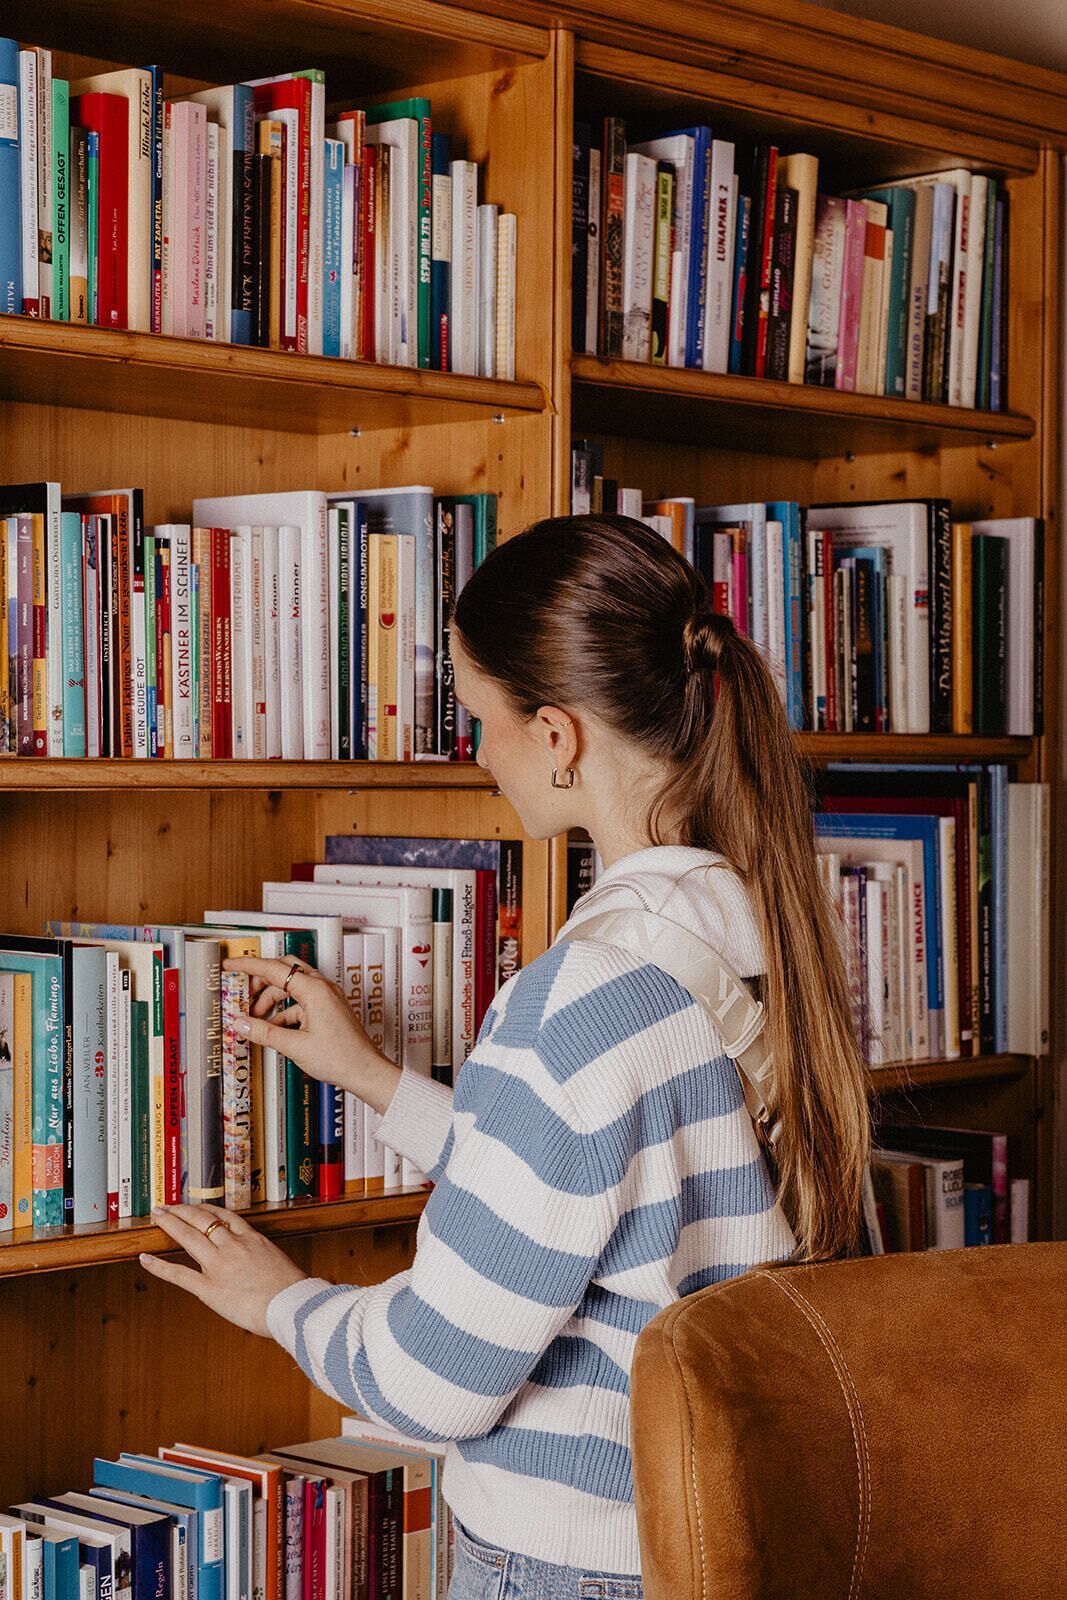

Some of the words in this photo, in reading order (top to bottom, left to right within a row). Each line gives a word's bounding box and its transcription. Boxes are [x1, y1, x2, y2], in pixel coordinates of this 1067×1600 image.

[140, 82, 151, 116] Liebe
[302, 90, 312, 132] Einsteiger
[141, 116, 151, 158] Blinde
[302, 133, 310, 148] für
[57, 151, 66, 200] GESAGT
[78, 140, 86, 182] geschaffen
[206, 158, 216, 190] nichts
[301, 149, 310, 189] Trennkost
[206, 192, 216, 210] ihr
[302, 190, 310, 216] Meine
[367, 166, 375, 233] Schlankwandern
[718, 184, 729, 192] 2
[57, 204, 66, 244] OFFEN
[154, 200, 162, 242] ZAPLETAL
[206, 210, 215, 231] seid
[421, 216, 430, 256] HOLZER
[716, 197, 728, 262] LUNAPARK
[154, 243, 162, 260] PAT
[191, 226, 201, 266] Dietrich
[207, 234, 215, 252] uns
[192, 266, 201, 306] Marlene
[206, 255, 215, 280] Ohne
[300, 256, 308, 283] Ursula
[421, 258, 430, 284] SEPP
[6, 280, 15, 313] MALIK
[242, 274, 253, 311] BUCK
[772, 268, 781, 317] HIGHLAND
[912, 286, 922, 327] ADAMS
[912, 334, 921, 393] RICHARD
[119, 511, 128, 542] Hobby
[319, 506, 327, 539] Gaudi
[120, 544, 130, 598] gesundeste
[177, 538, 188, 598] SCHNEE
[360, 522, 368, 609] KONSUMTROTTEL
[120, 599, 129, 618] das
[290, 561, 300, 619] Männer
[178, 604, 189, 623] IM
[136, 657, 145, 677] ROT
[178, 630, 190, 699] KÄSTNER
[137, 682, 145, 715] GUIDE
[202, 708, 210, 726] 333
[124, 712, 132, 748] Pahlow
[137, 719, 146, 748] WEIN
[382, 717, 390, 756] ullstein
[404, 724, 412, 751] DUMONT
[461, 884, 474, 958] Fitneß-Ratgeber
[914, 882, 923, 944] BALANCE
[914, 946, 924, 964] IN
[206, 963, 220, 991] Gitti
[368, 964, 384, 1026] Bibel
[46, 976, 60, 1032] Flamingo
[96, 983, 104, 1047] Kostbarkeiten
[206, 999, 221, 1041] Pluhar
[48, 1034, 59, 1074] Liebe,
[65, 1025, 73, 1077] SalzburgerLand
[94, 1050, 104, 1078] 39
[169, 1036, 178, 1084] GESAGT
[206, 1044, 221, 1077] Erika
[96, 1082, 104, 1097] der
[170, 1088, 178, 1127] OFFEN
[49, 1104, 59, 1128] Nur
[96, 1099, 104, 1122] Buch
[155, 1562, 166, 1598] Regeln
